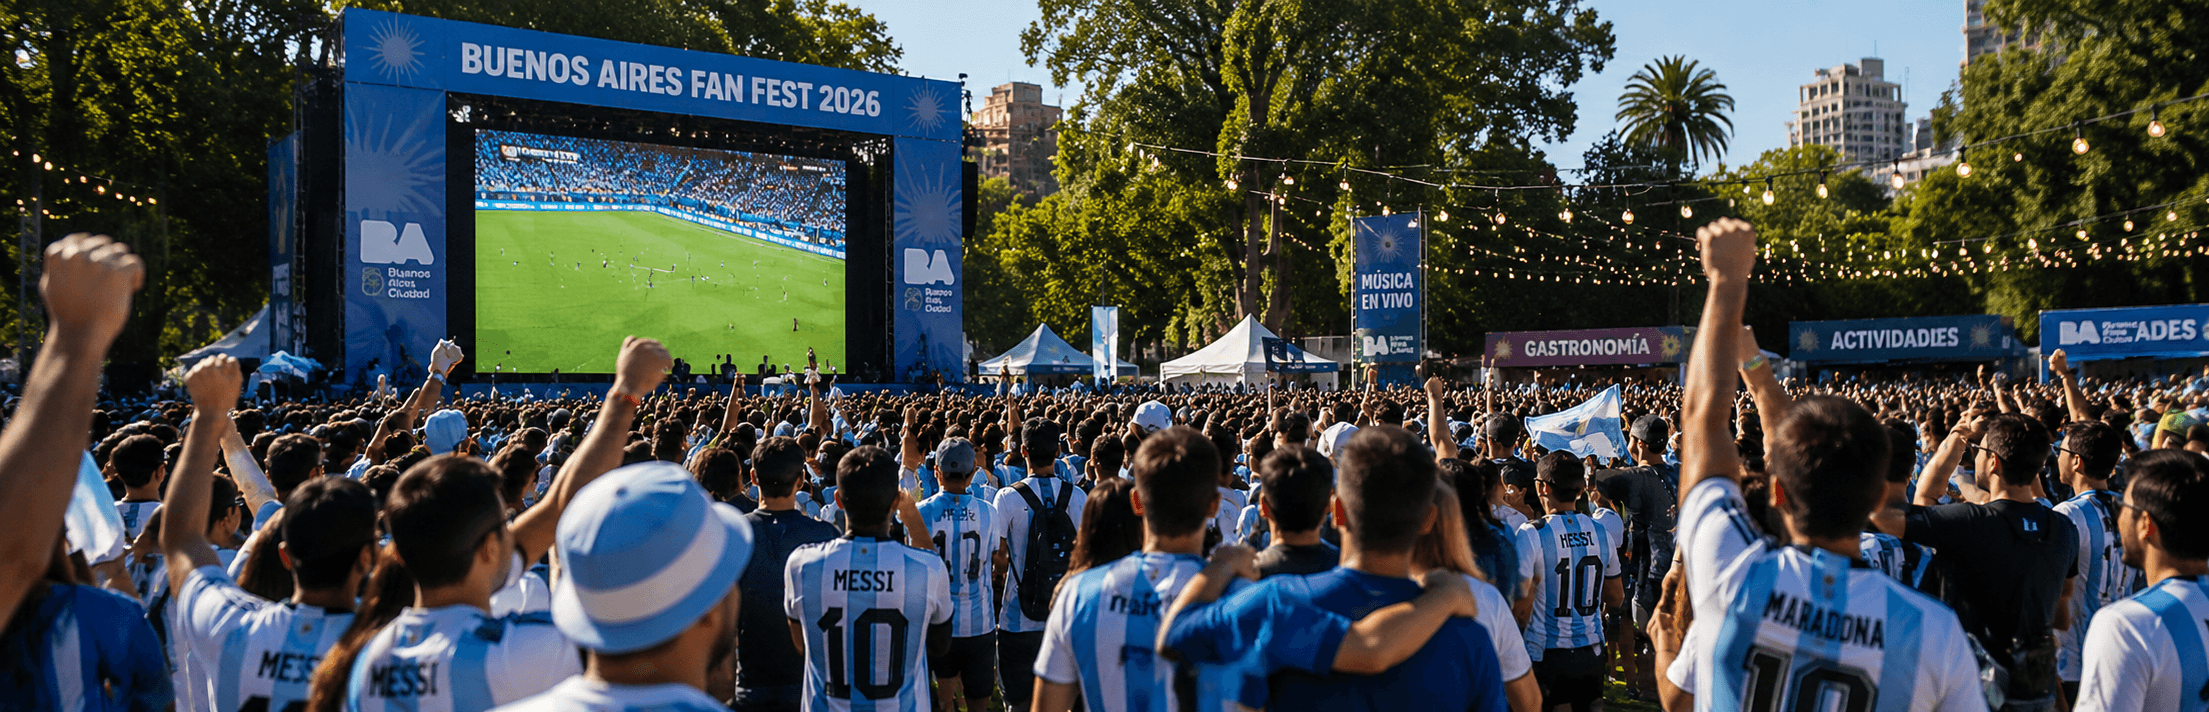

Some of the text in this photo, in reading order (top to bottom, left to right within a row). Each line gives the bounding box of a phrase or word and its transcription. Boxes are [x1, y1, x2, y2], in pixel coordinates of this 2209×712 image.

[461, 42, 881, 117] BUENOS AIRES FAN FEST 2026
[360, 220, 434, 265] BA
[904, 248, 955, 285] BA
[1361, 269, 1414, 290] MÚSICA
[1361, 292, 1413, 310] EN VIVO
[1362, 335, 1390, 357] BA
[1524, 333, 1651, 357] GASTRONOMÍA
[2059, 320, 2101, 345] BA
[2135, 319, 2197, 342] ADES
[833, 569, 895, 592] MESSI
[1553, 555, 1604, 618] 10
[1763, 590, 1886, 649] MARADONA
[257, 650, 321, 683] MES
[817, 607, 909, 700] 10
[368, 660, 439, 698] MESSI
